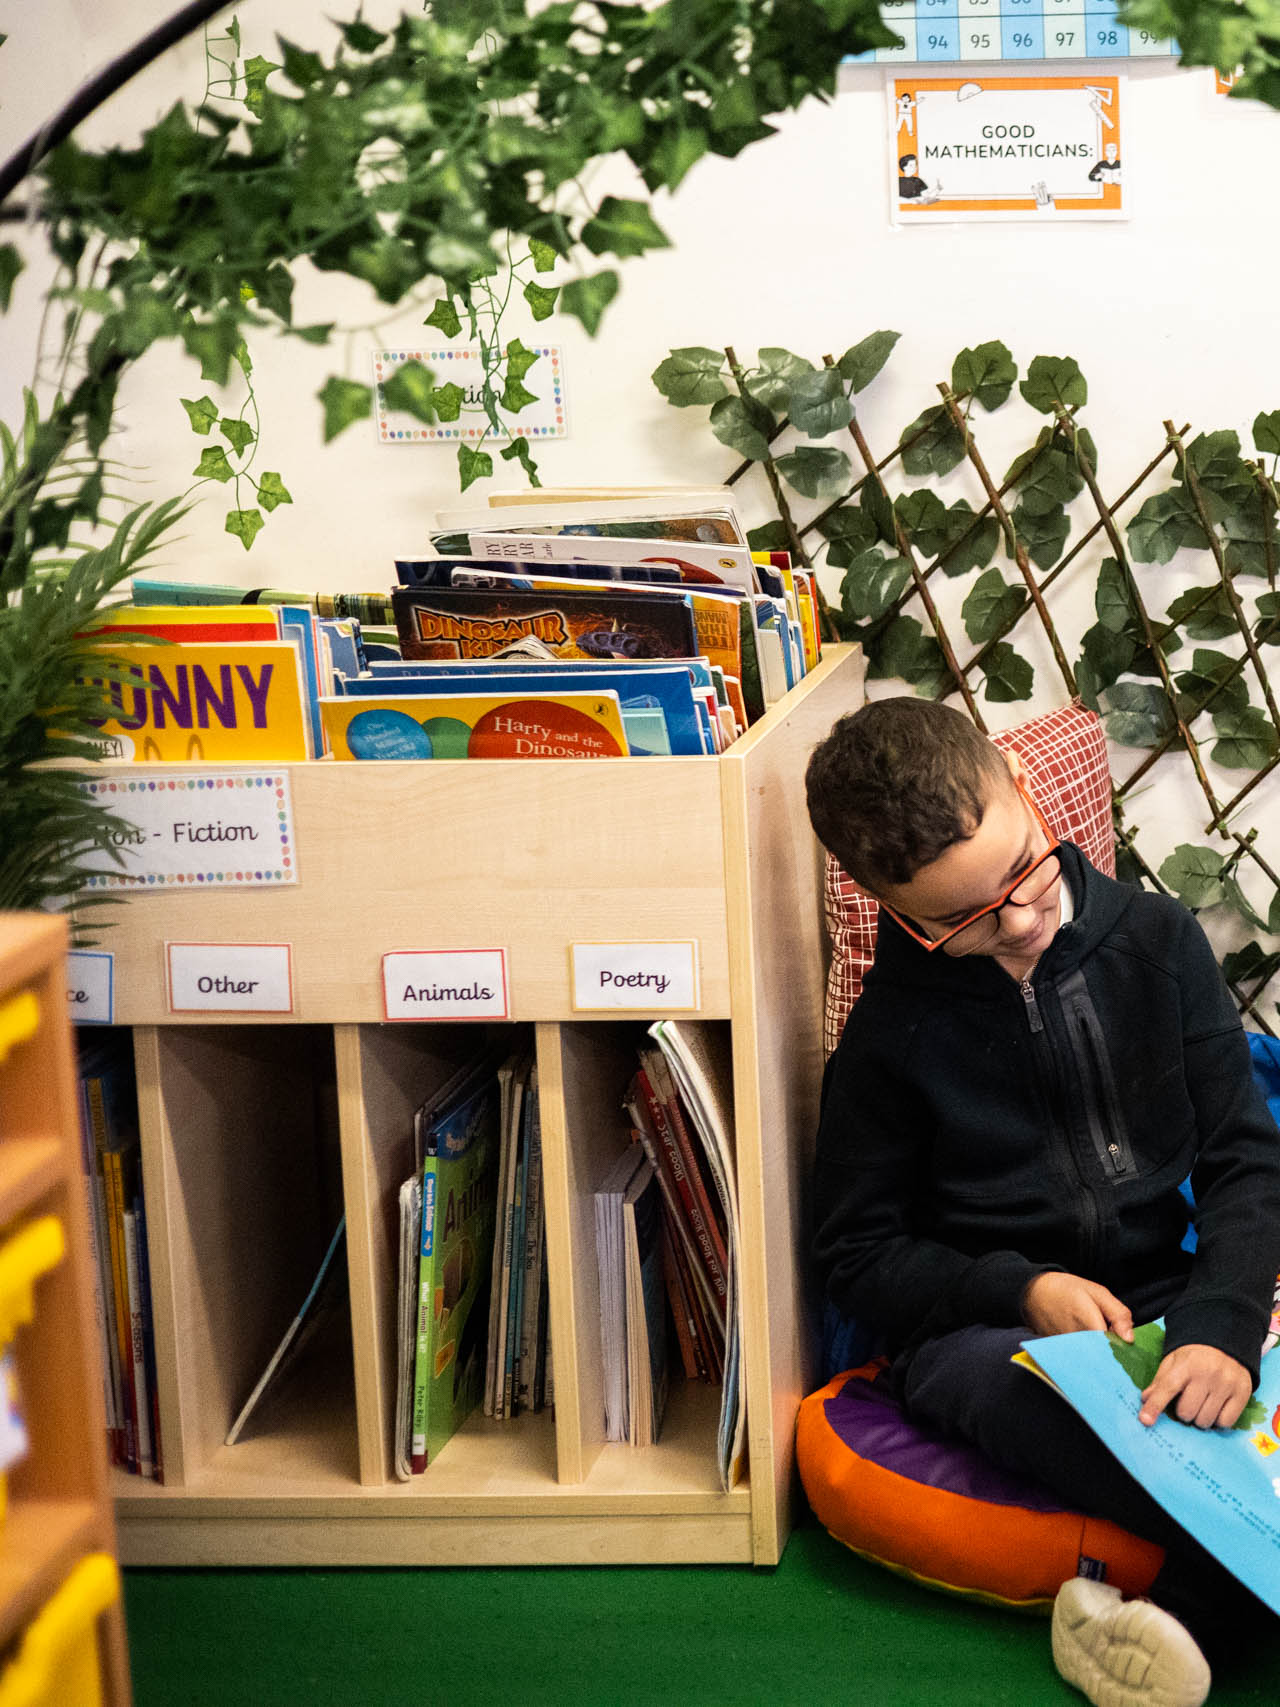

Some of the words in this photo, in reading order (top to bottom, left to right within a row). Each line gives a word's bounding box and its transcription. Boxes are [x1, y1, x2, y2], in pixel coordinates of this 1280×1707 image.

[928, 35, 948, 49] 94
[970, 34, 990, 48] 95
[1012, 33, 1033, 47] 96
[1055, 32, 1075, 46] 97
[1097, 31, 1118, 45] 98
[982, 125, 1035, 139] GOOD
[925, 144, 1094, 159] MATHEMATICIANS:
[417, 610, 565, 644] DINOSAUR
[461, 639, 511, 659] KIN
[75, 664, 274, 730] UNNY
[494, 717, 552, 741] Harry
[555, 732, 579, 743] and
[582, 737, 604, 749] the
[173, 821, 259, 843] Fiction
[197, 975, 260, 994] Other
[402, 982, 496, 1002] Animals
[599, 970, 671, 994] Poetry
